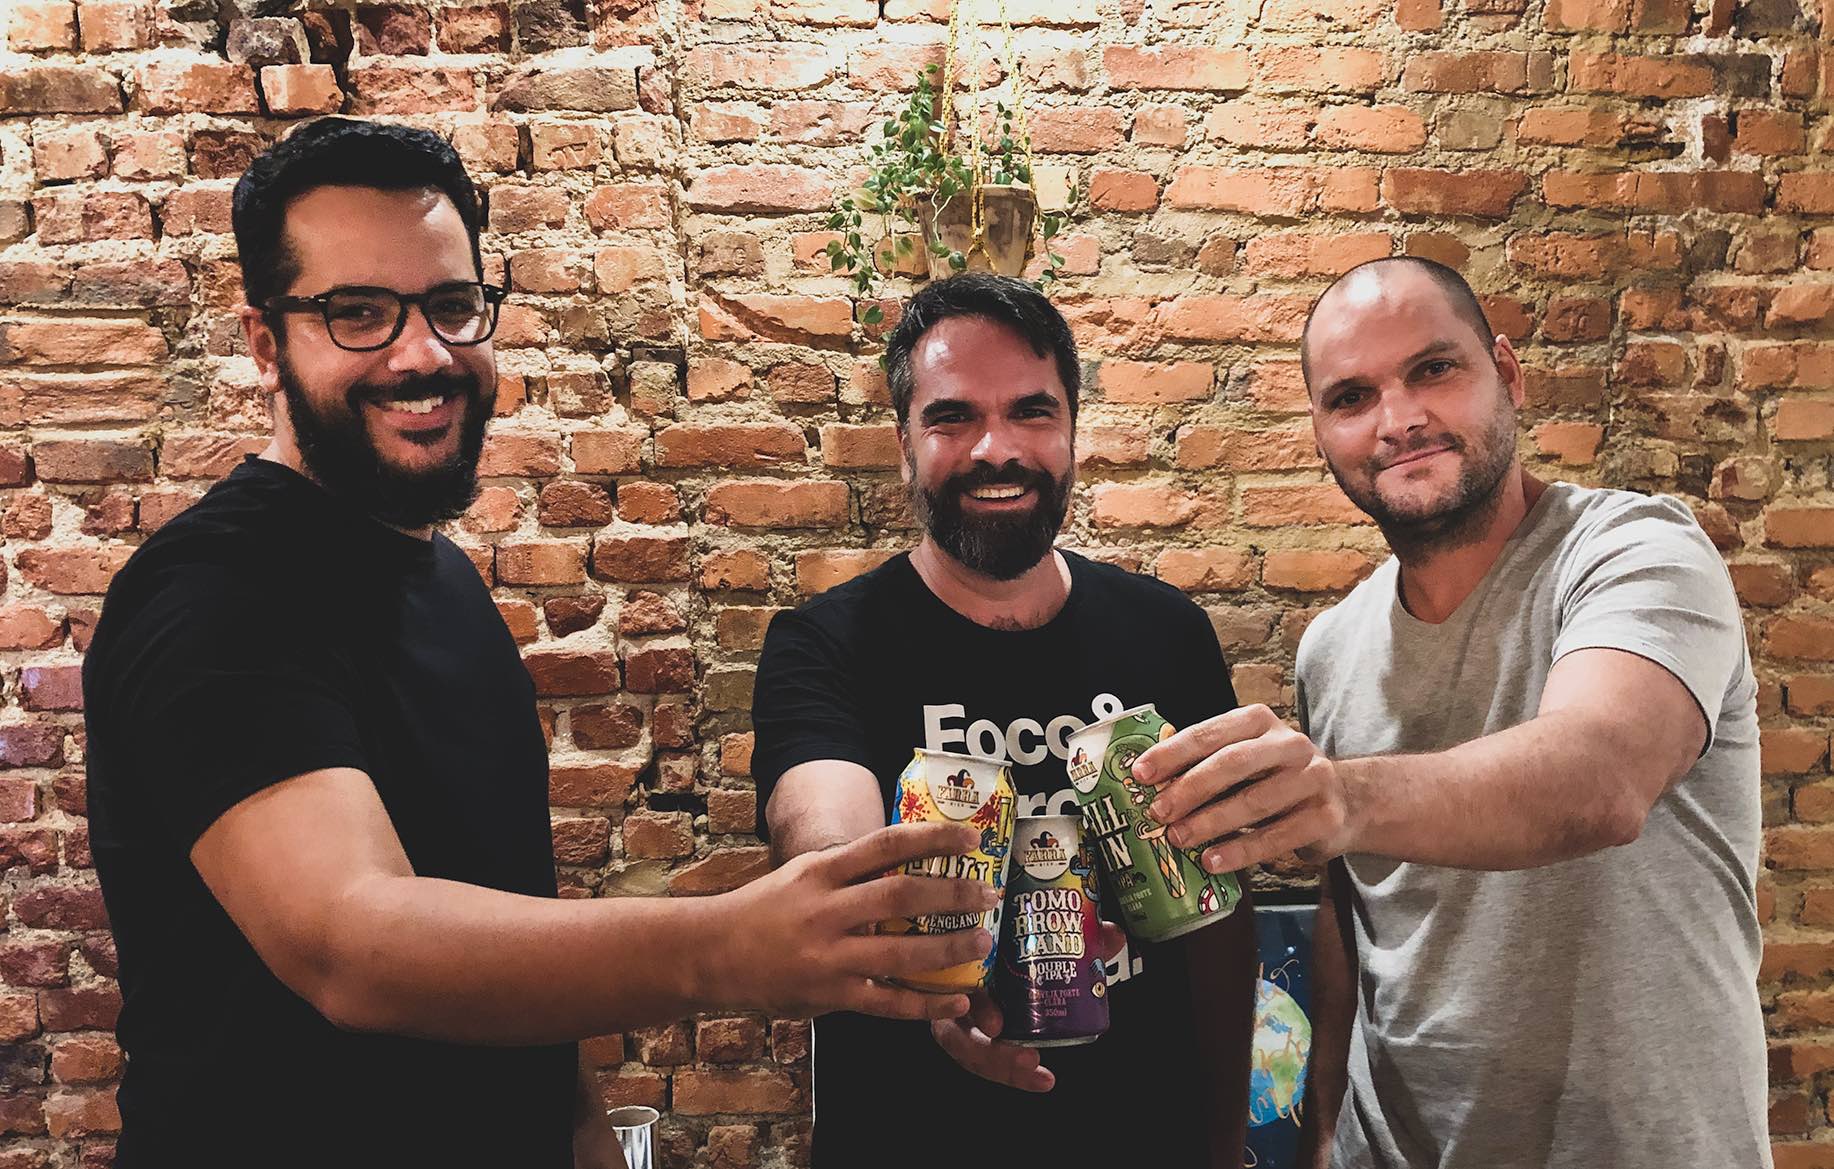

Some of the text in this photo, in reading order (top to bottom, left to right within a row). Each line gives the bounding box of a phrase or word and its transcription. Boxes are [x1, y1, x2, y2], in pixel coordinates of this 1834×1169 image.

[1098, 830, 1134, 872] IN
[1014, 888, 1083, 917] TOMO
[929, 912, 980, 929] ENGLAND
[1018, 933, 1086, 959] LAND
[1045, 970, 1063, 981] IPA
